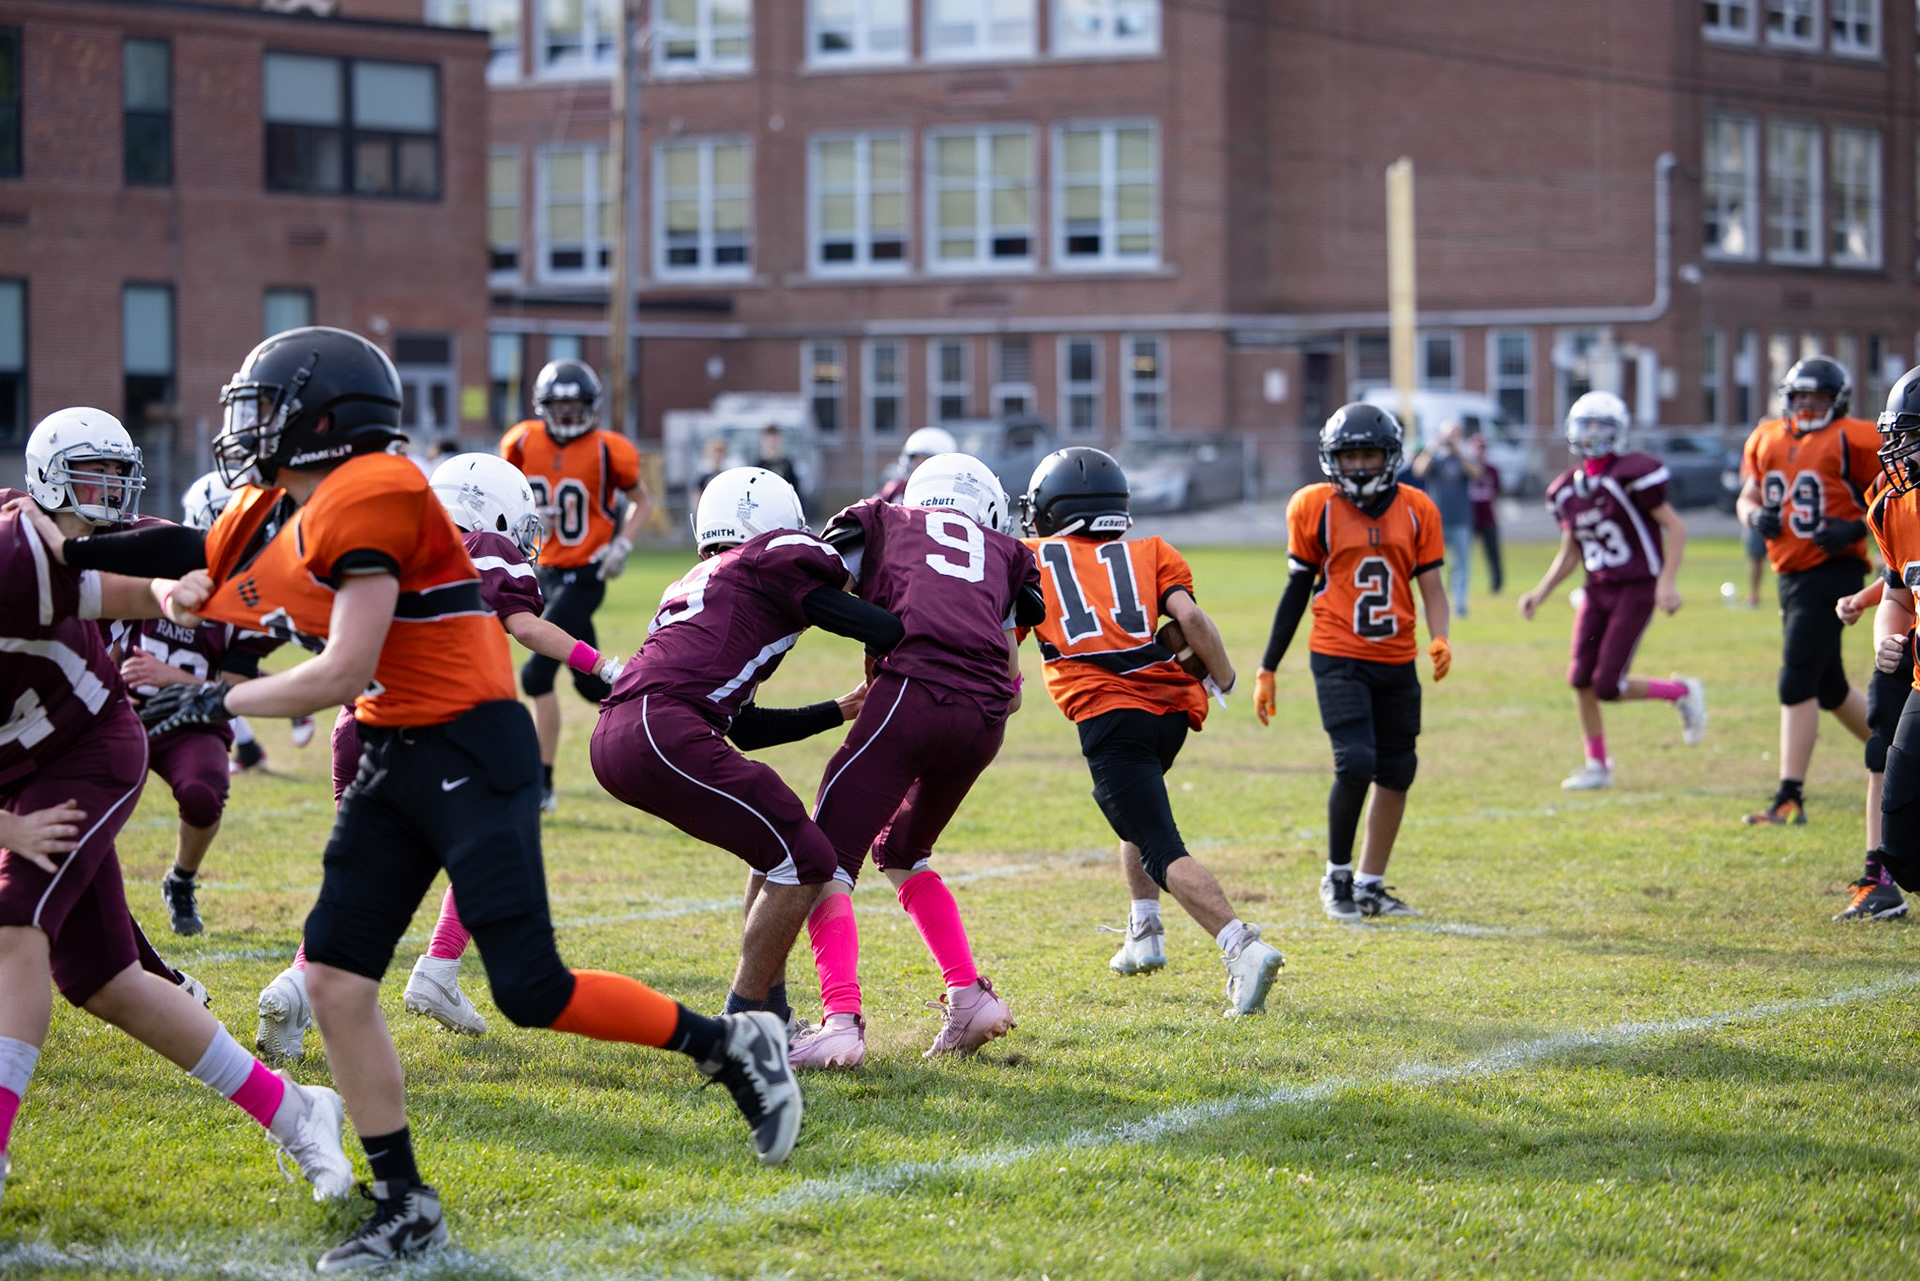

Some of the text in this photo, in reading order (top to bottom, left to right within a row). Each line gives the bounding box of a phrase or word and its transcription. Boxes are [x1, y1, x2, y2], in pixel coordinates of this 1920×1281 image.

[701, 528, 736, 541] XENITH
[925, 511, 985, 583] 9
[1367, 527, 1380, 547] U
[1037, 540, 1151, 647] 11
[1353, 556, 1398, 642] 2
[156, 618, 196, 645] RAMS
